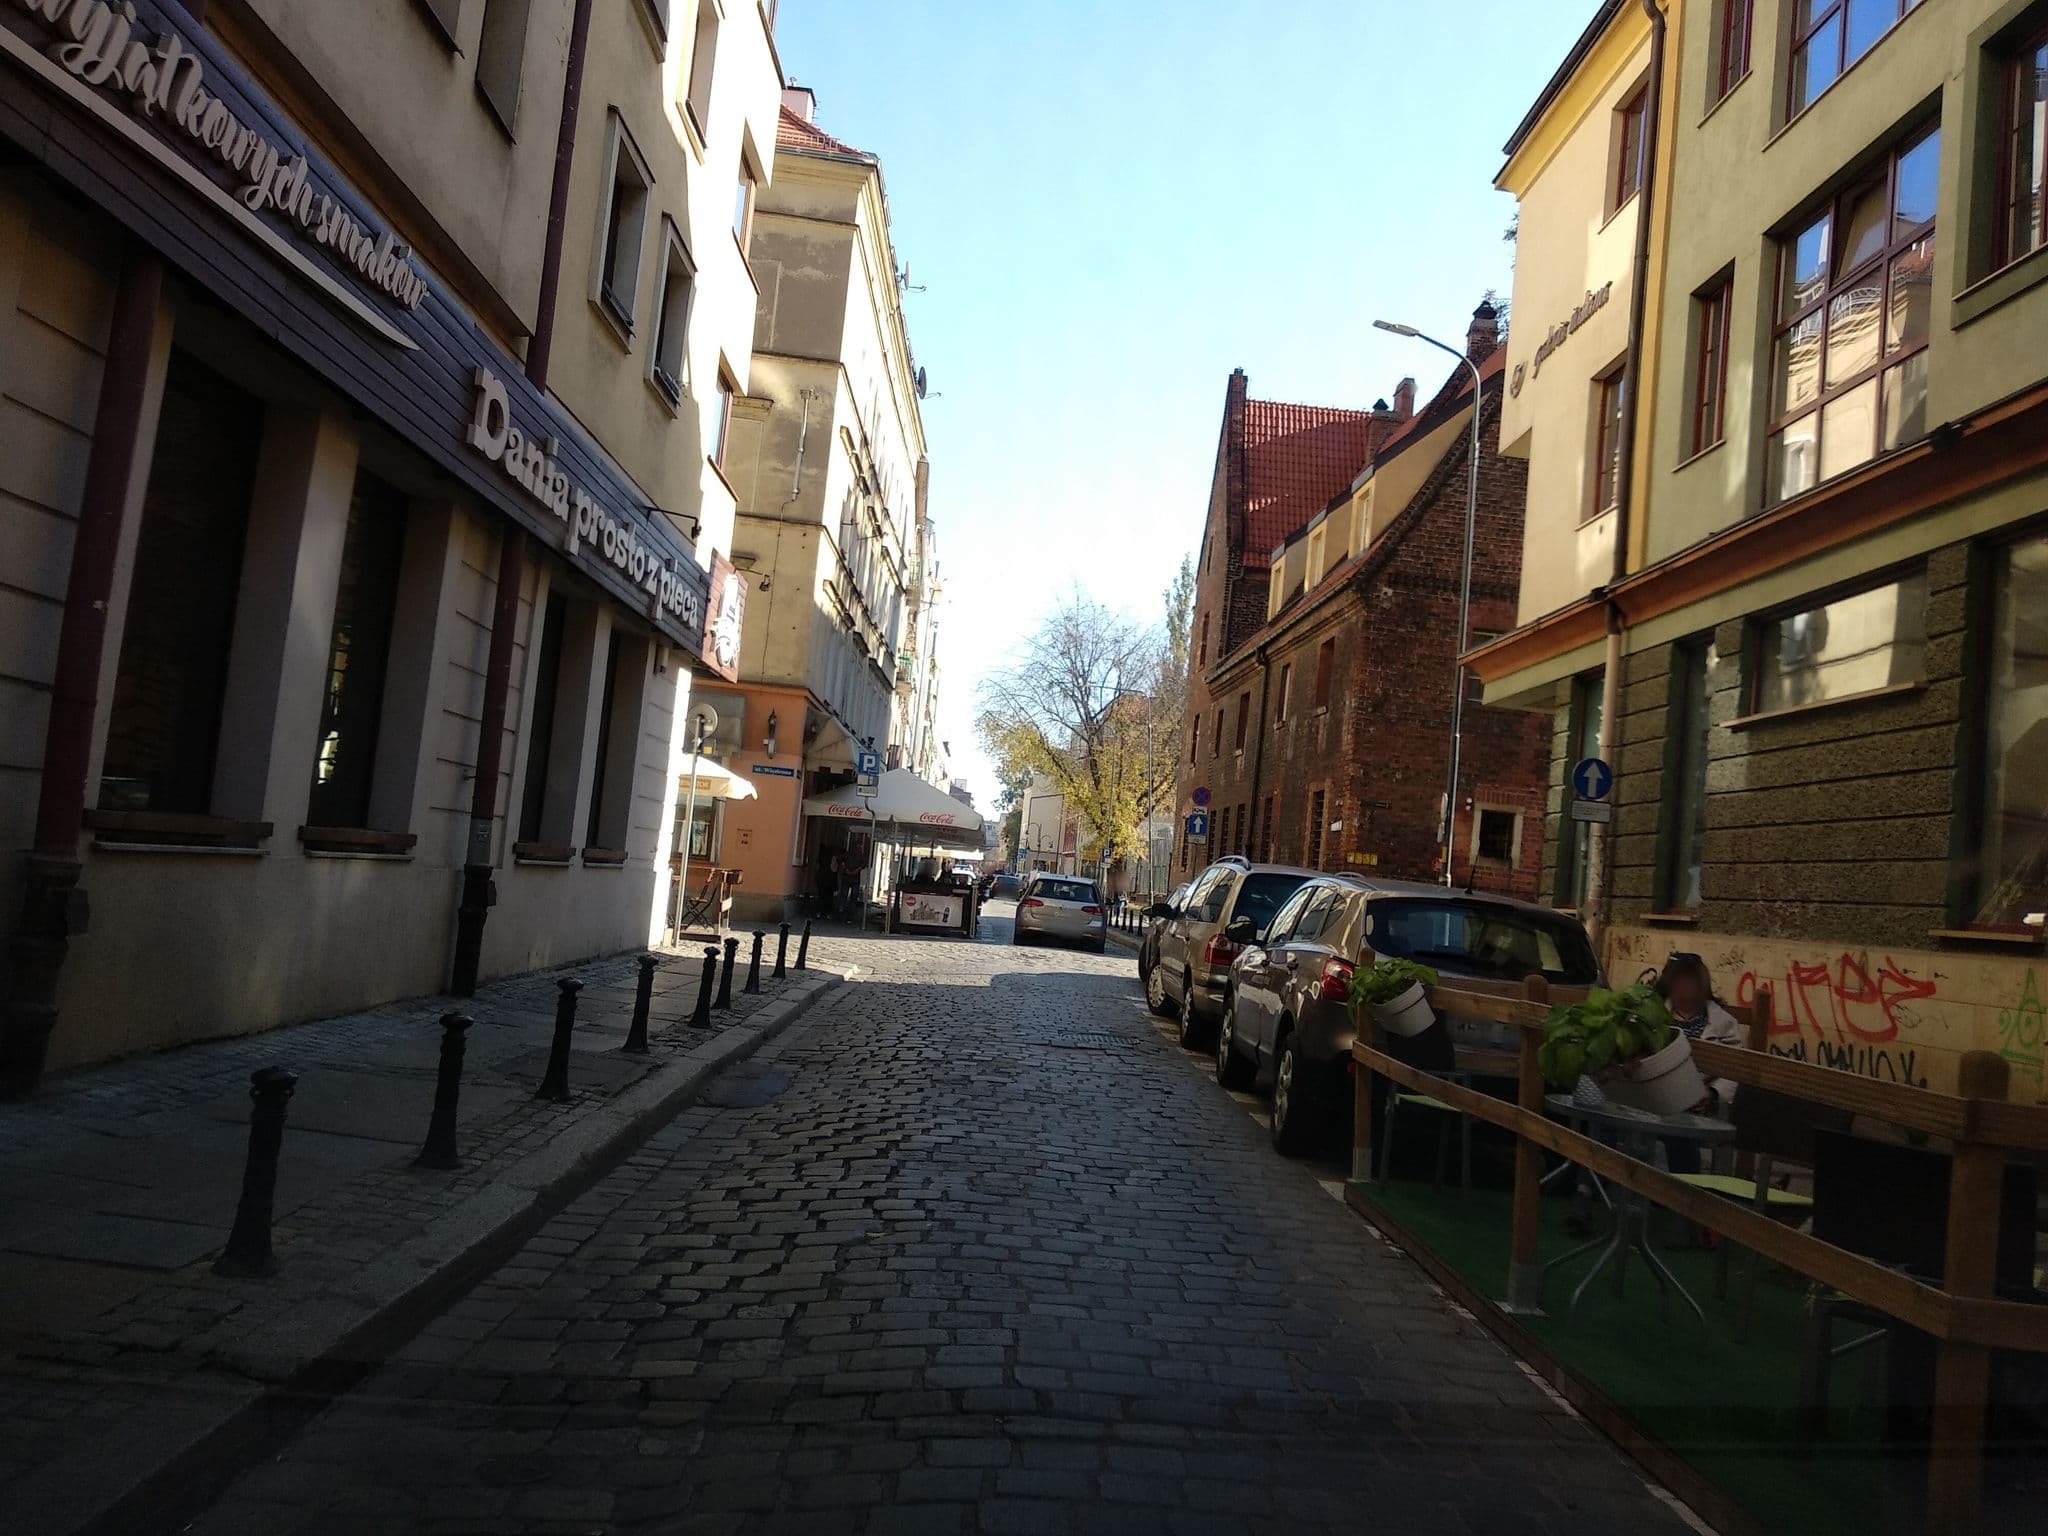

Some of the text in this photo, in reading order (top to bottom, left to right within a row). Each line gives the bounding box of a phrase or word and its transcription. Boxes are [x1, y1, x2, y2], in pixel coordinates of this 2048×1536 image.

[316, 193, 430, 311] smaków
[467, 365, 699, 630] Dania prosto z pieca
